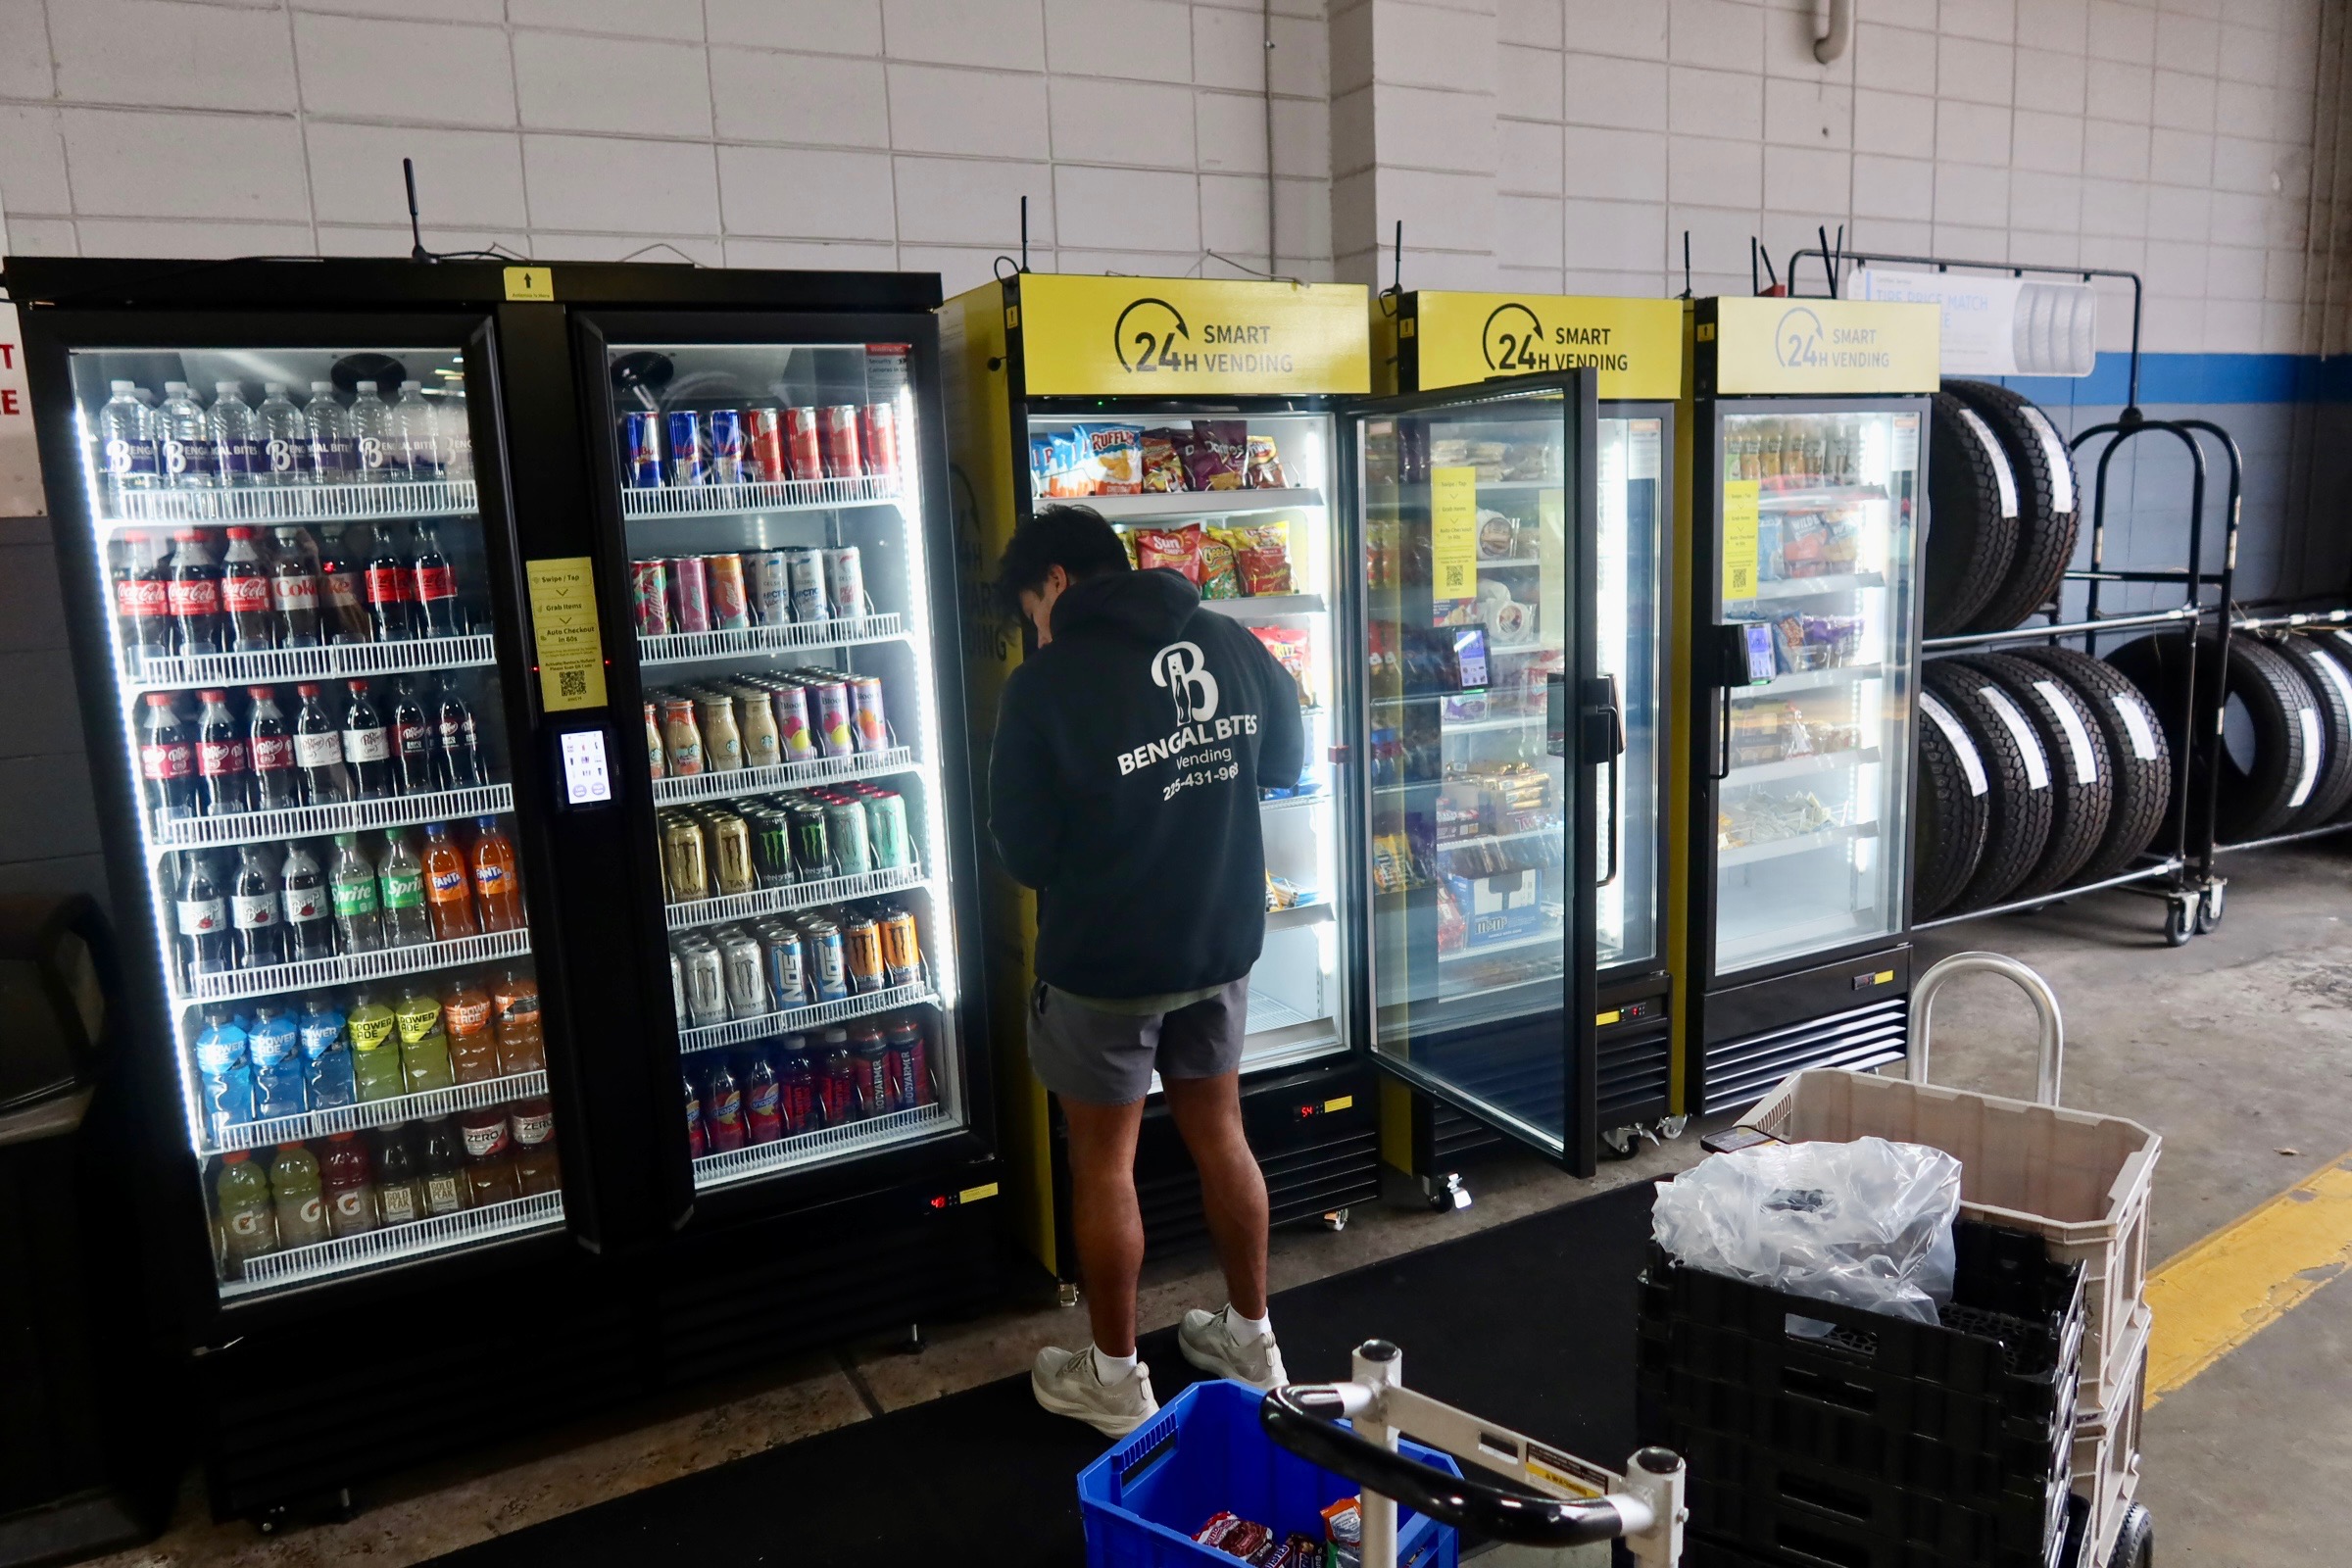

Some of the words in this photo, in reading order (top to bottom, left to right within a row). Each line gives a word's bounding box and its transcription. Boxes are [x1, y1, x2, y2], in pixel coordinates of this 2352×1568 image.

[1947, 294, 1987, 311] MATCH
[1203, 324, 1271, 344] SMART
[1555, 326, 1611, 345] SMART
[1834, 329, 1877, 345] SMART
[1204, 354, 1294, 373] VENDING
[1555, 354, 1628, 371] VENDING
[1833, 352, 1889, 368] VENDING
[1203, 441, 1245, 457] Doritos
[1152, 535, 1180, 550] Sun
[1116, 723, 1214, 776] BENGAL
[1214, 714, 1257, 741] BTES
[1176, 747, 1232, 771] Vending
[332, 886, 371, 902] Sprite
[356, 1017, 392, 1031] POWER
[400, 1011, 435, 1025] POWER
[357, 1029, 378, 1040] ADE
[1301, 1104, 1313, 1118] 54
[467, 1130, 500, 1143] ZERO
